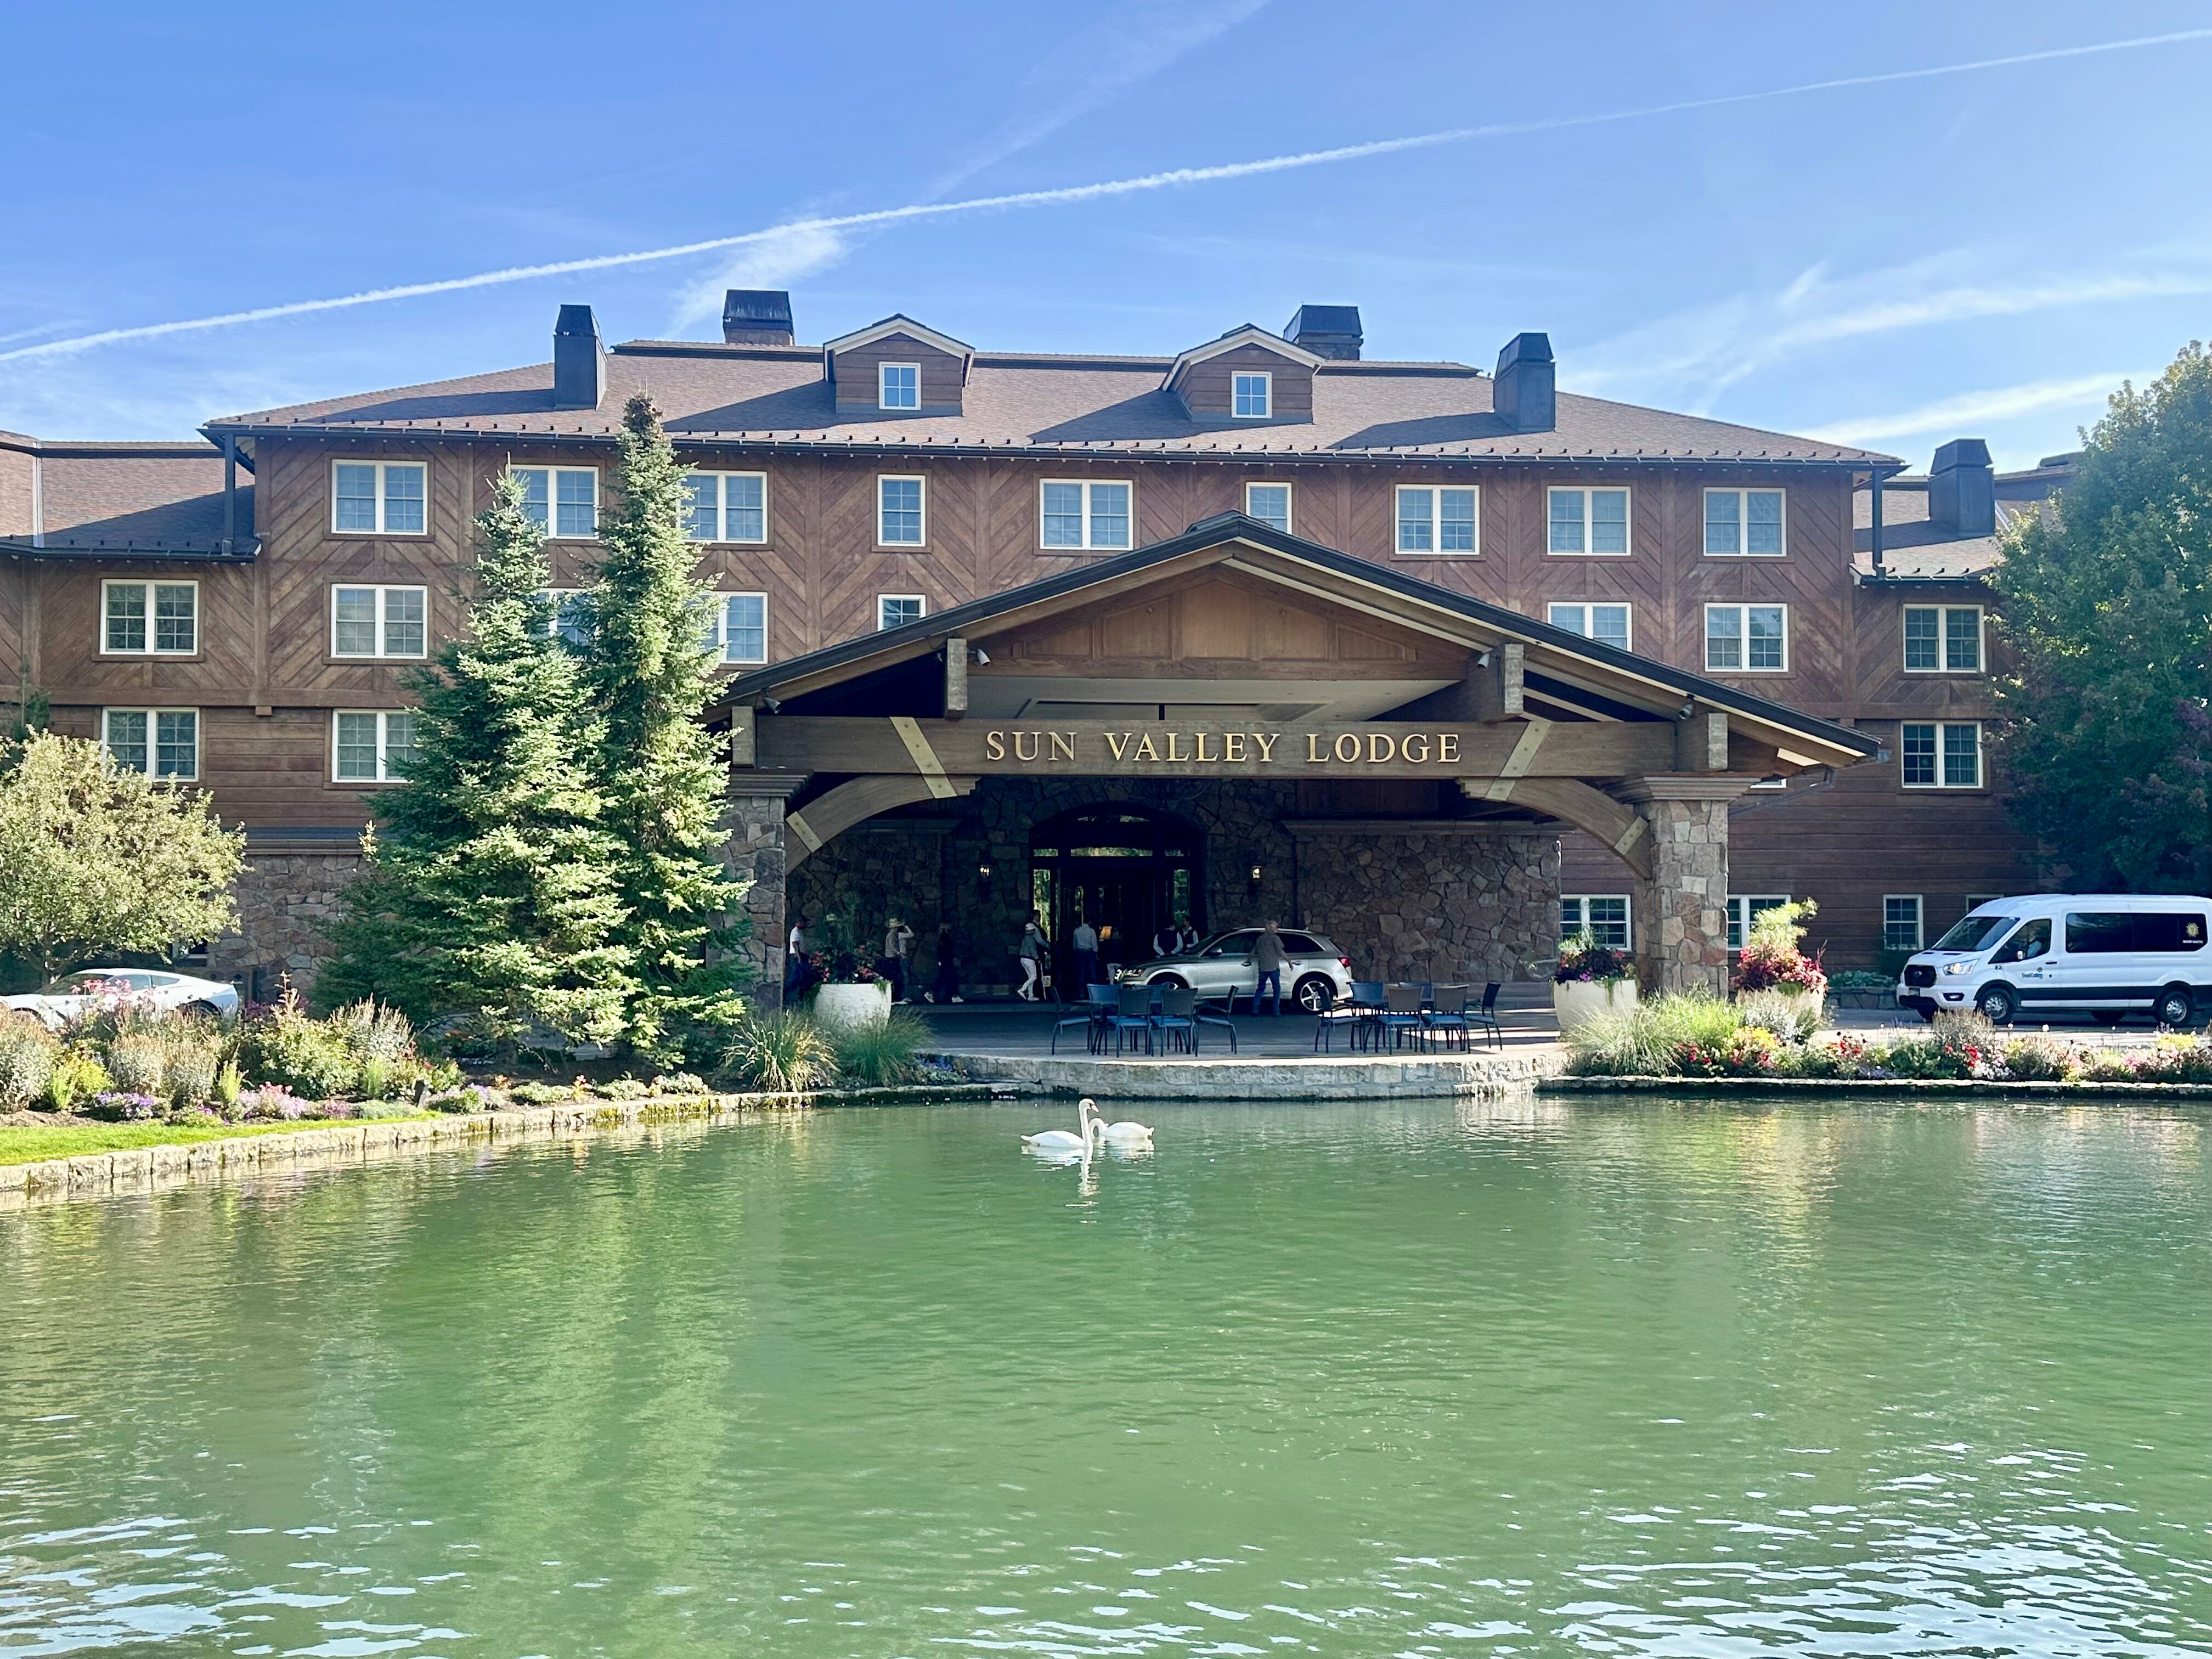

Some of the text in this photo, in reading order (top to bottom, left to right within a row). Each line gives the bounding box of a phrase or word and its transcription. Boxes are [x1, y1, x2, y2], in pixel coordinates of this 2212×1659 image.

[986, 731, 1461, 764] SUN VALLEY LODGE
